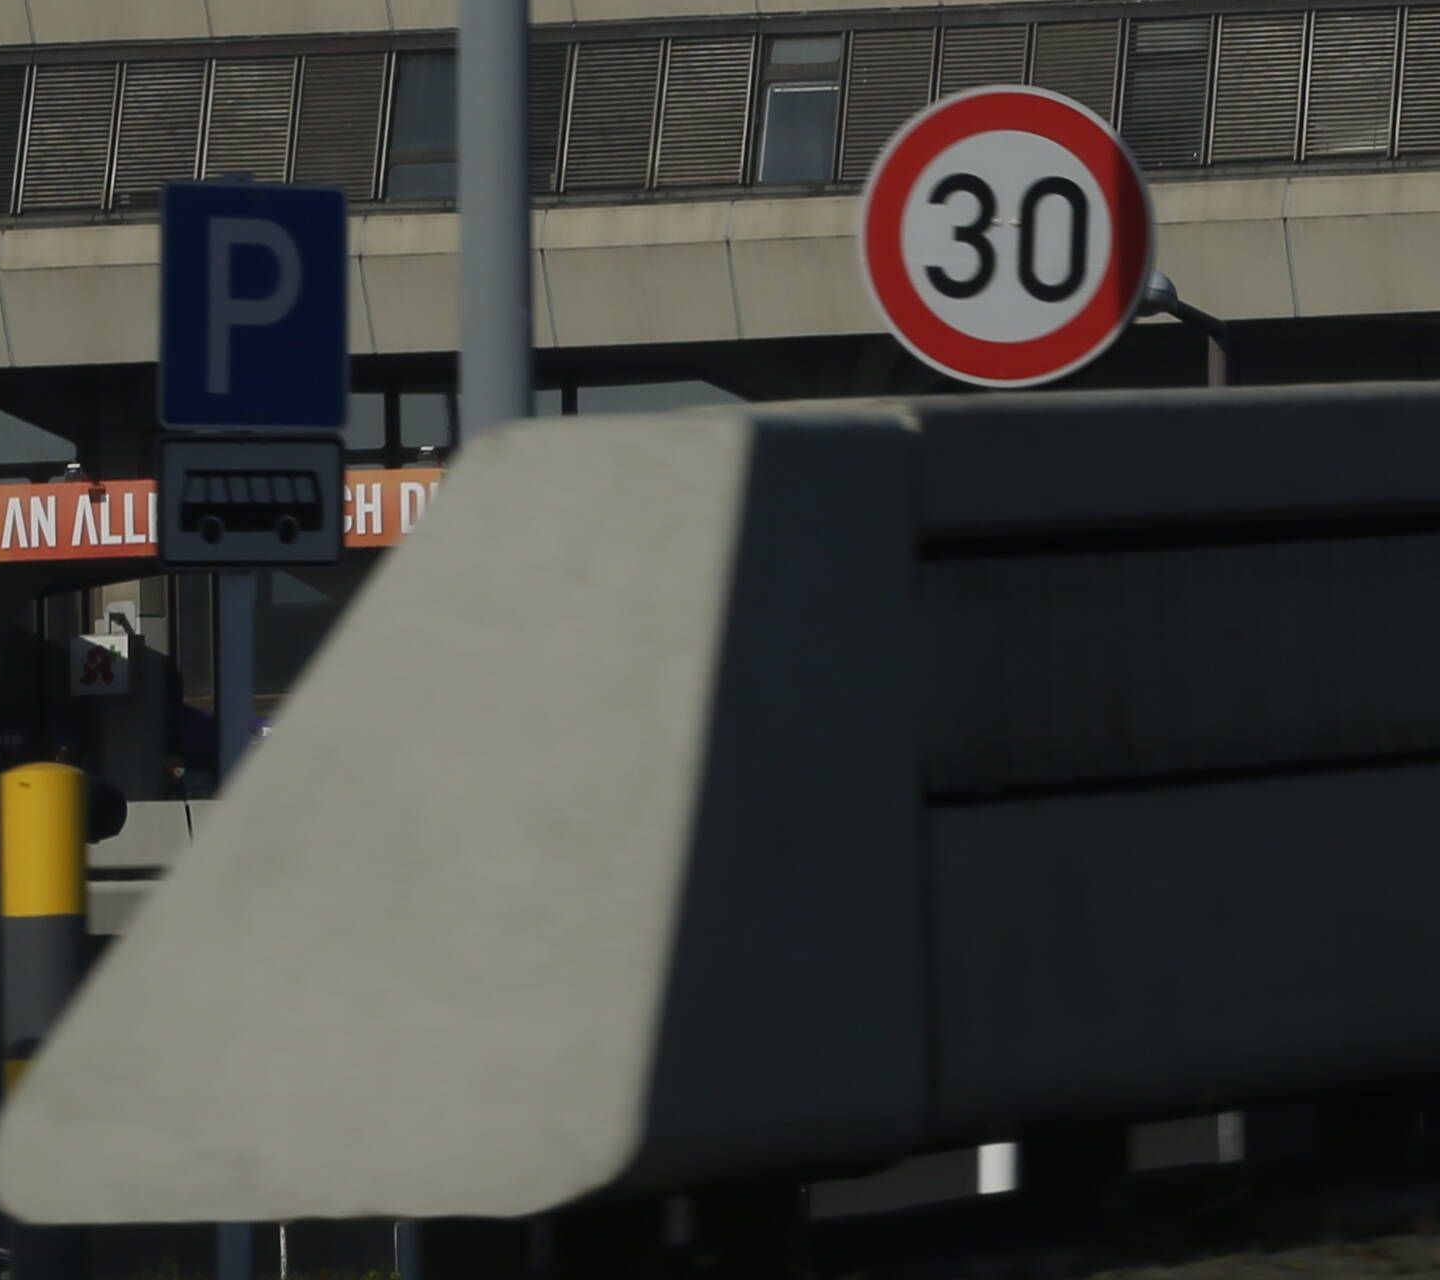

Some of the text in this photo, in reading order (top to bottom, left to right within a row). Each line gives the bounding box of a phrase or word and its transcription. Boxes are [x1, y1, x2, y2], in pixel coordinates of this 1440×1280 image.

[924, 173, 1090, 303] 30
[207, 216, 303, 394] P
[1, 495, 56, 550] AN
